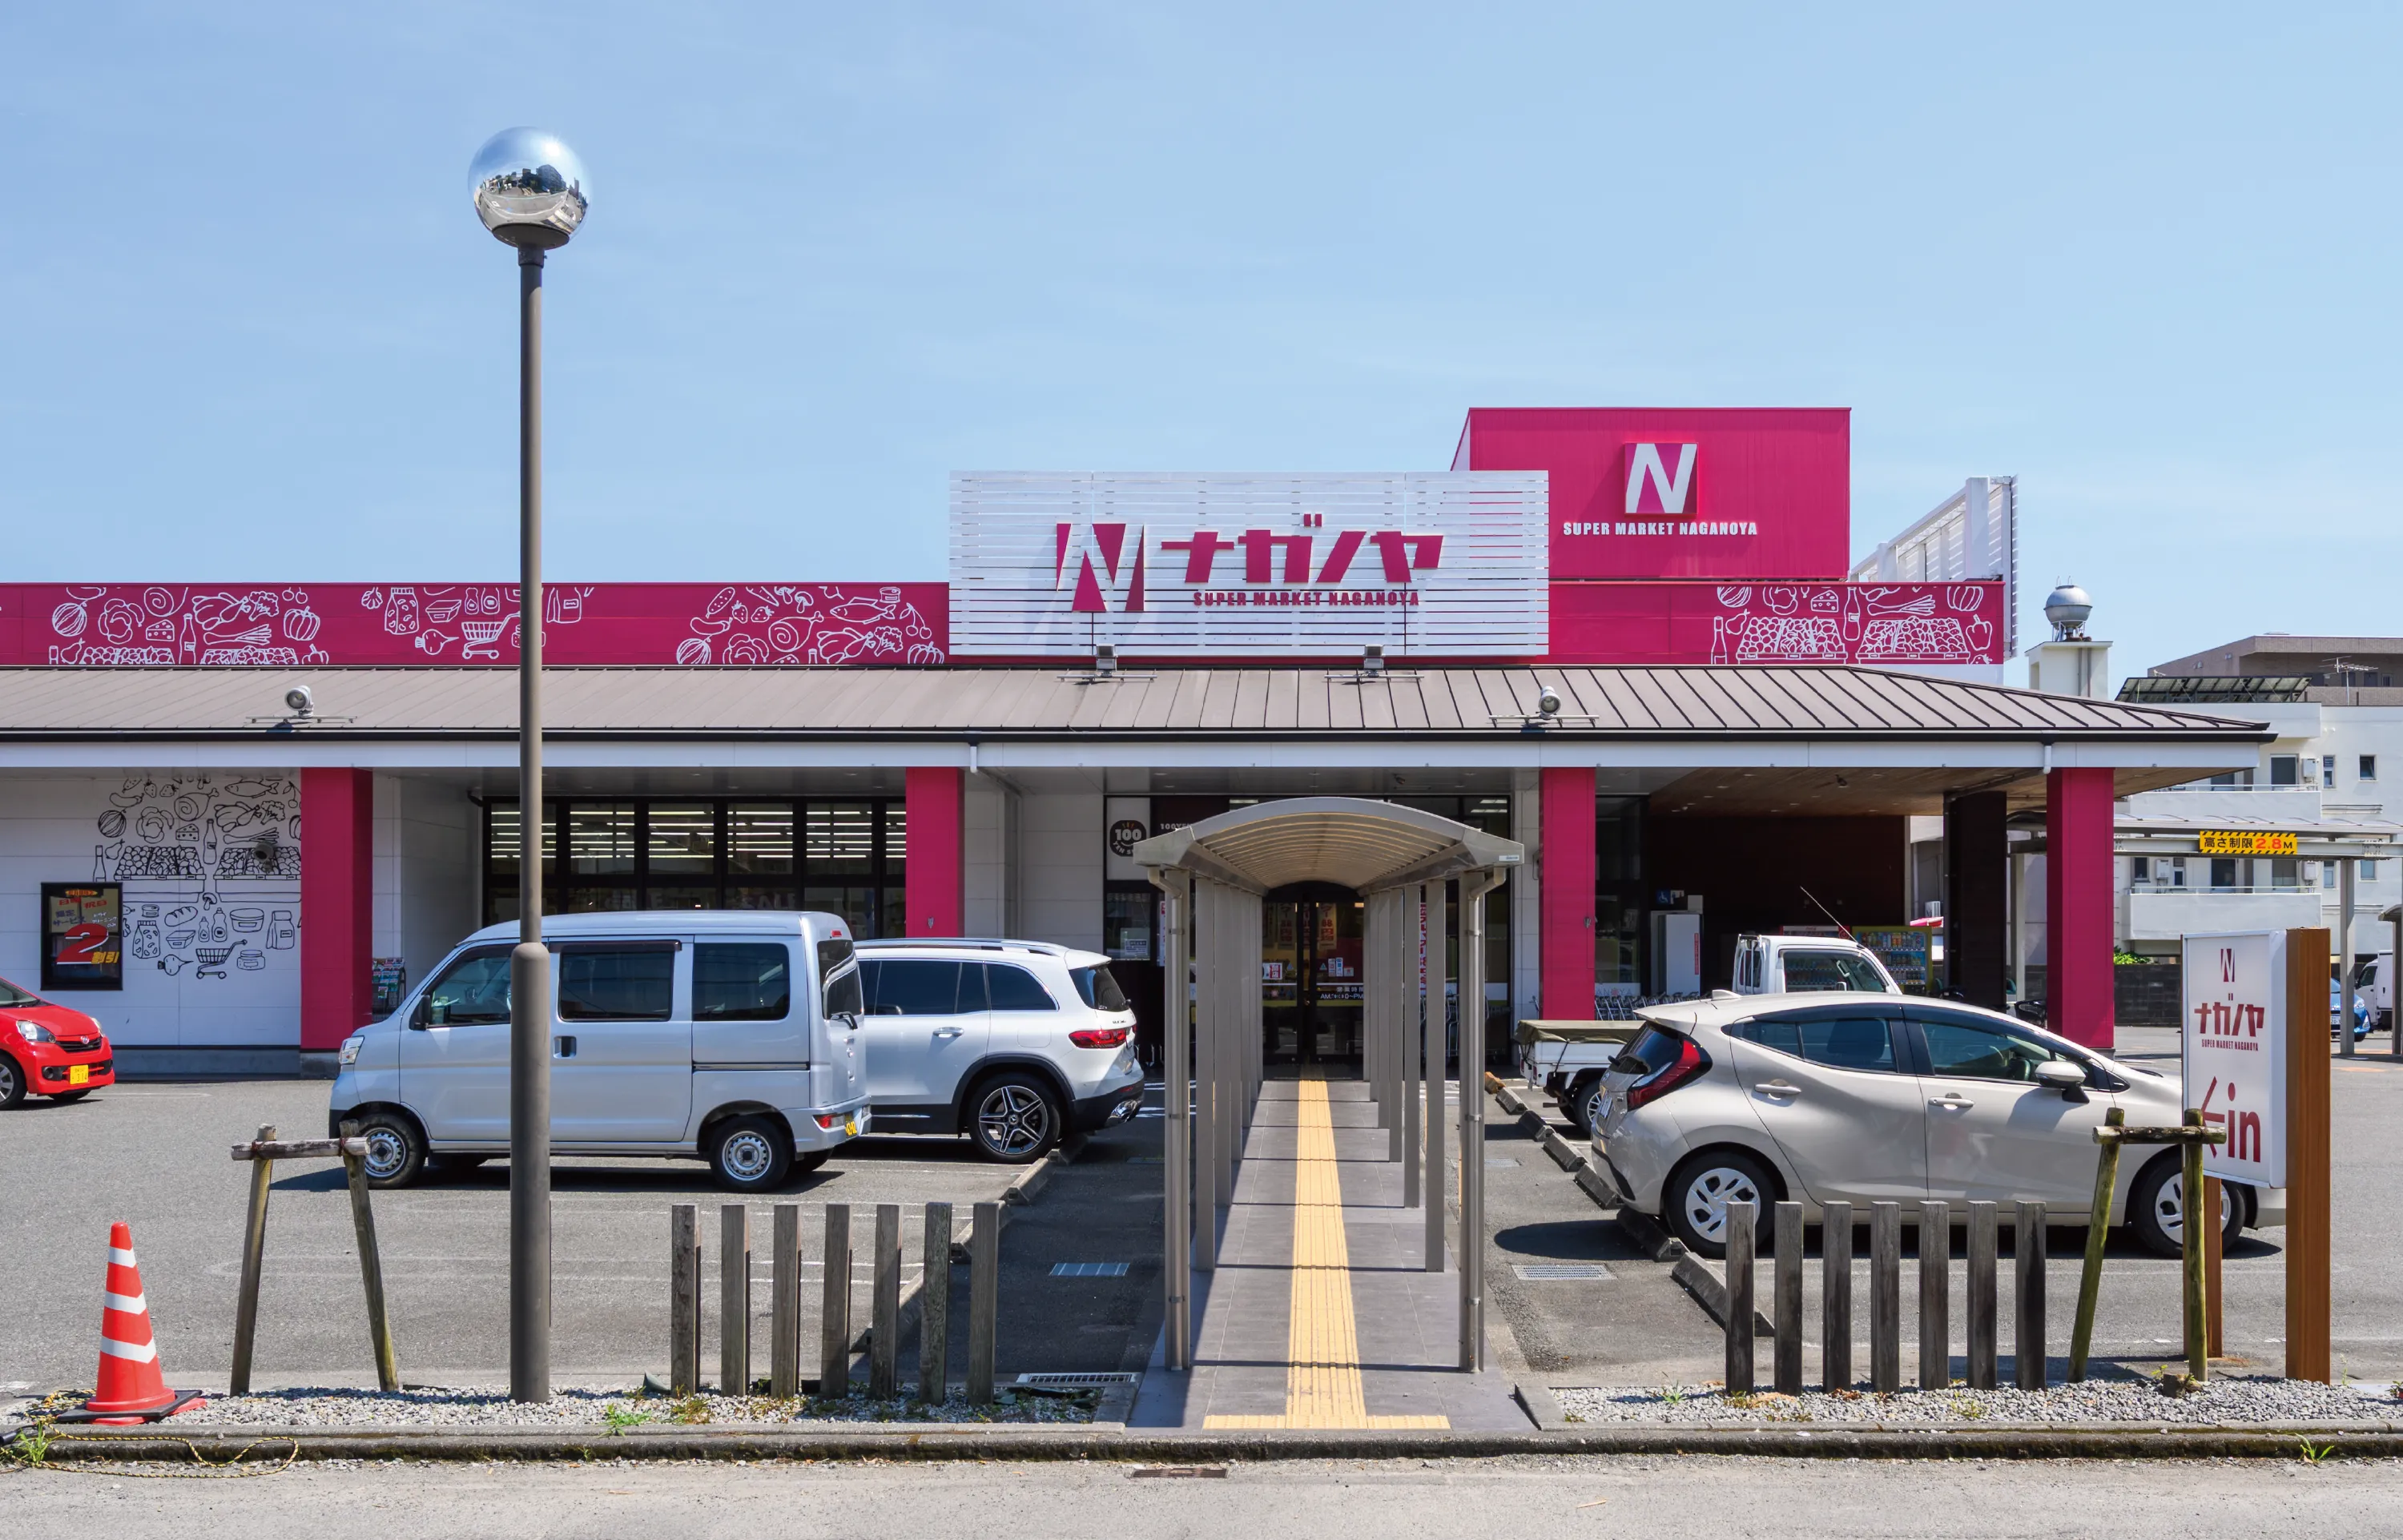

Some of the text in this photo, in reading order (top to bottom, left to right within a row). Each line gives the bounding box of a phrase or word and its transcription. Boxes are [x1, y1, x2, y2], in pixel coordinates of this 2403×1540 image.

[1626, 443, 1697, 513] N
[1161, 513, 1443, 583] ナガノヤ
[1564, 522, 1757, 536] SUPER MARKET NAGANOYA
[1056, 523, 1144, 613] N
[1193, 592, 1419, 606] SUPER MARKET NAGANOYA
[1115, 828, 1142, 841] 100
[2194, 993, 2265, 1038] ナガノヤ
[2201, 1039, 2259, 1051] SUPER MARKET NAGANOYA
[2228, 1082, 2261, 1163] in
